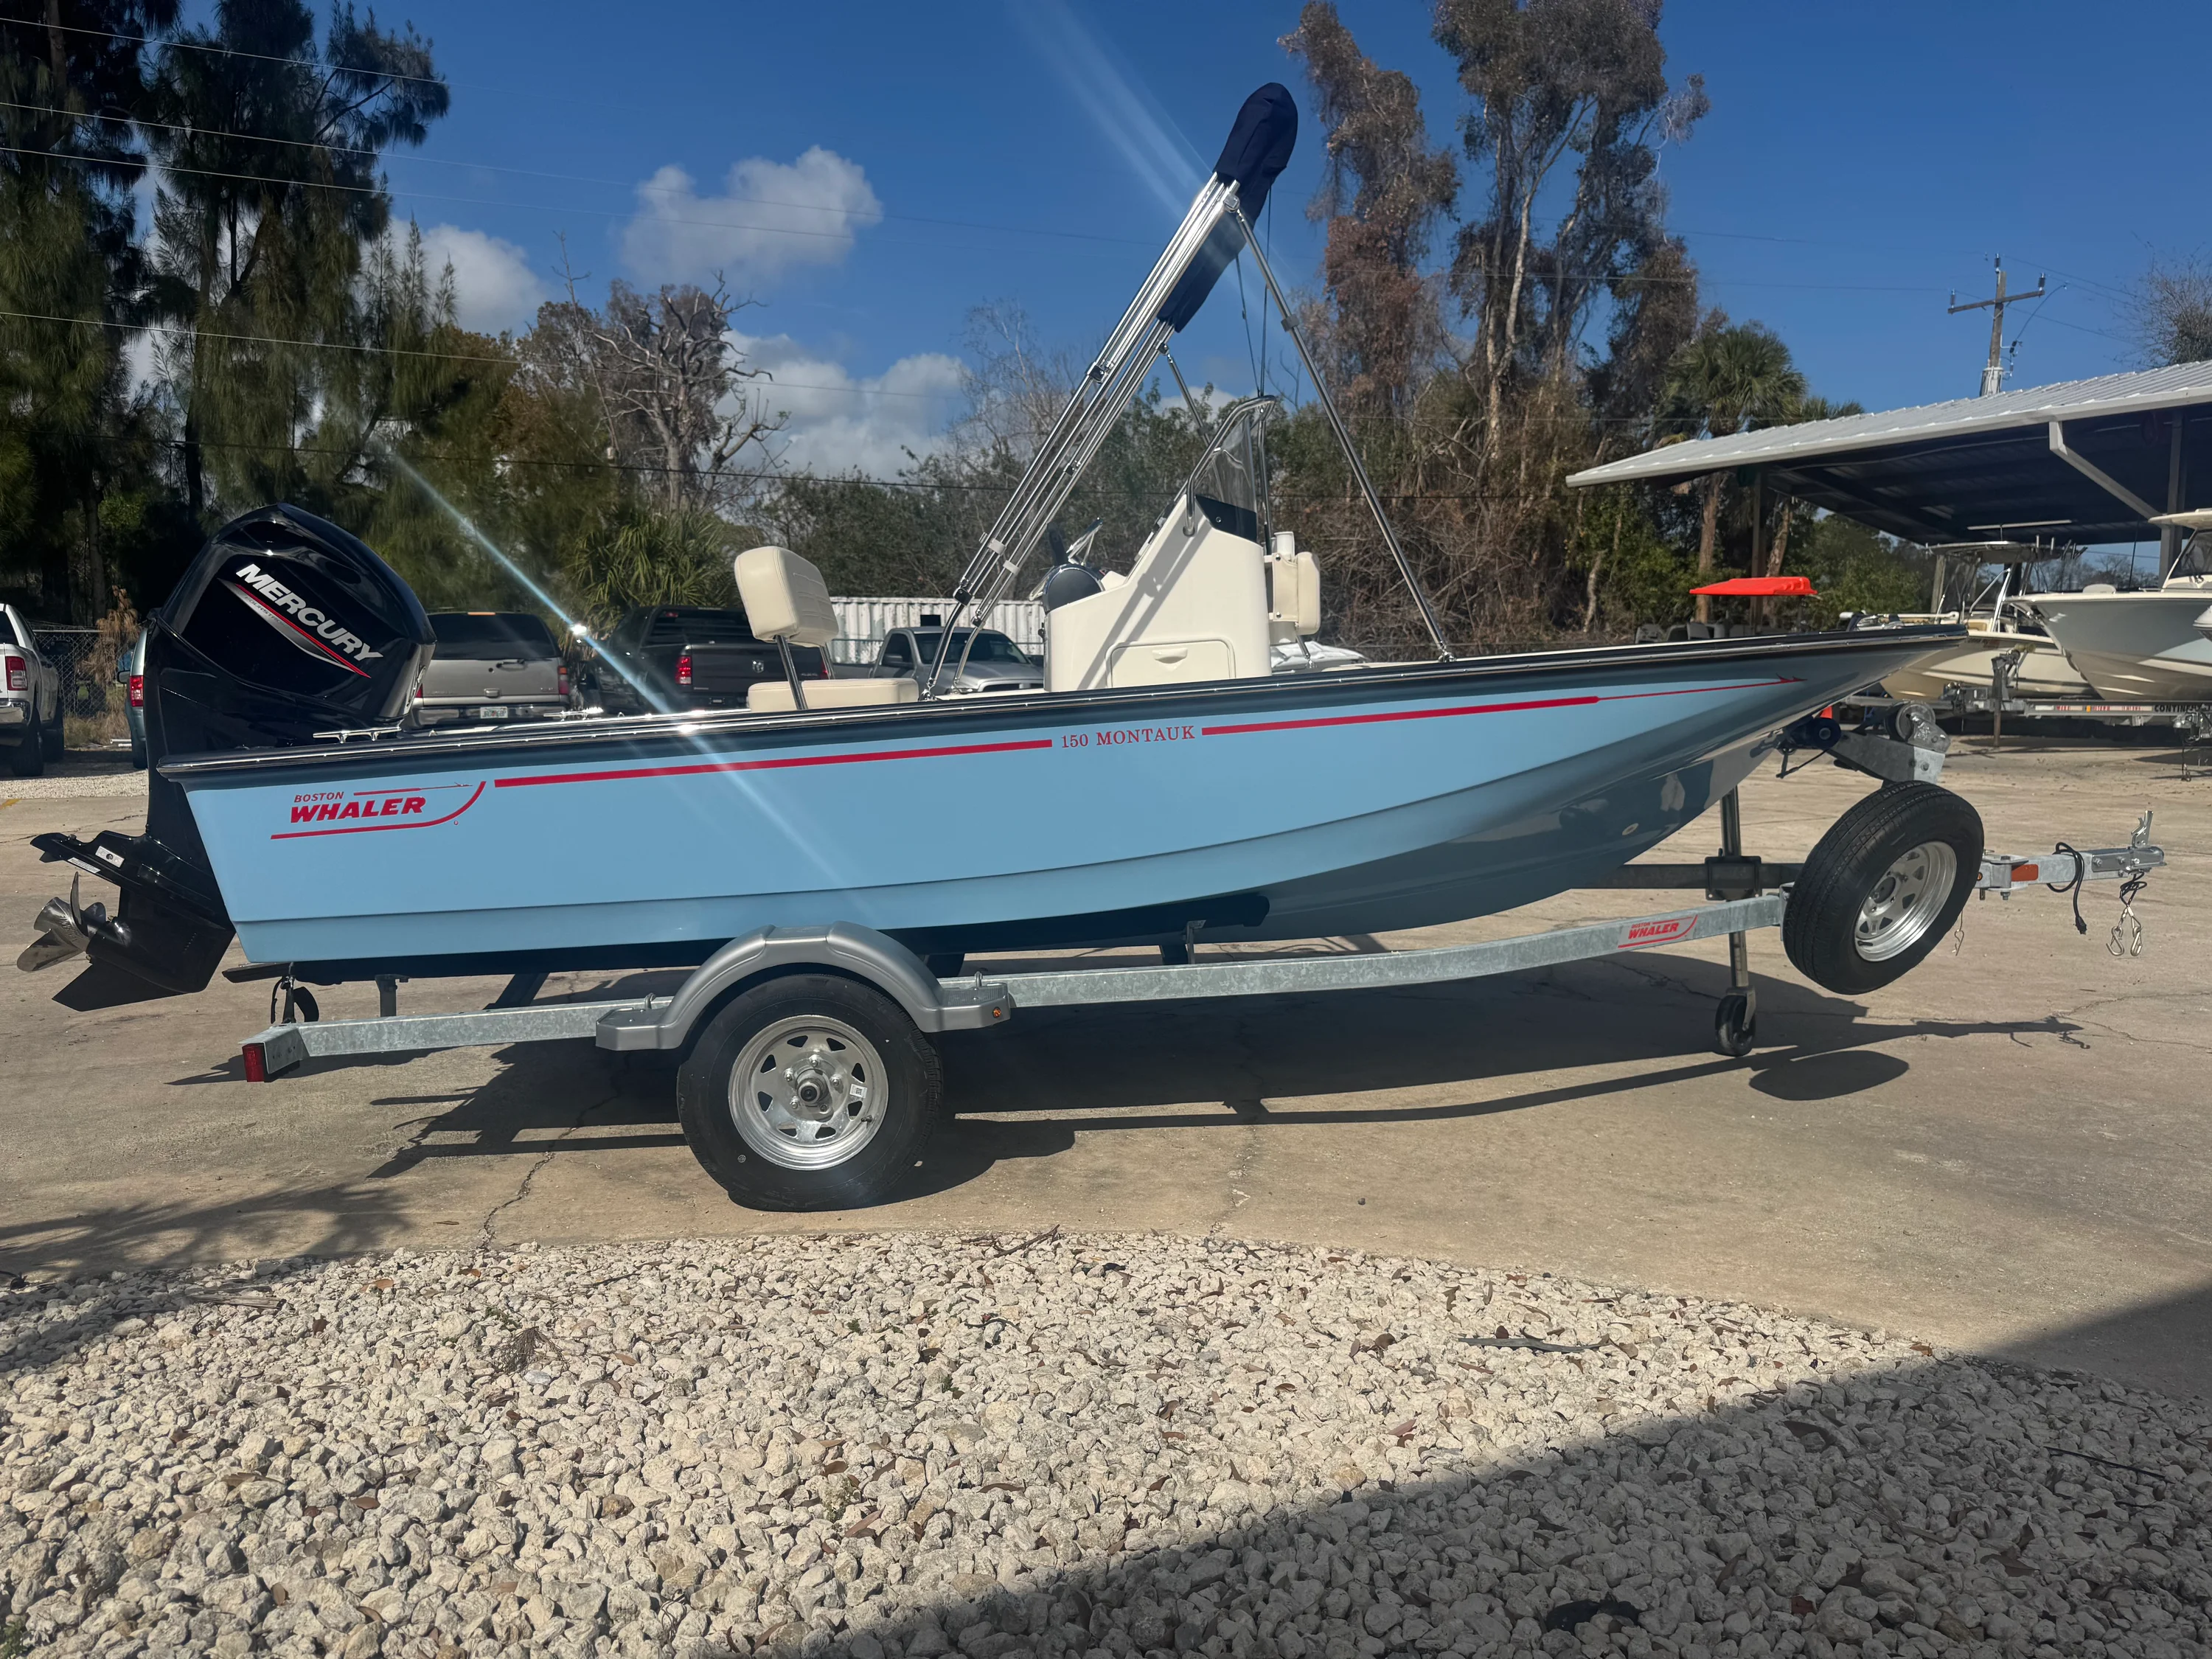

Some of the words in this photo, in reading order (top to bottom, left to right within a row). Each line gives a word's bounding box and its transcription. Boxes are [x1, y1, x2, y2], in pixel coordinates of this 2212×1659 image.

[235, 563, 384, 661] MERCURY
[244, 595, 288, 627] FOURSTRO
[1062, 734, 1089, 748] 150
[1096, 726, 1196, 746] MONTAUK
[293, 791, 344, 803] BOSTON
[291, 796, 426, 824] WHALER
[1628, 922, 1680, 940] WHALER
